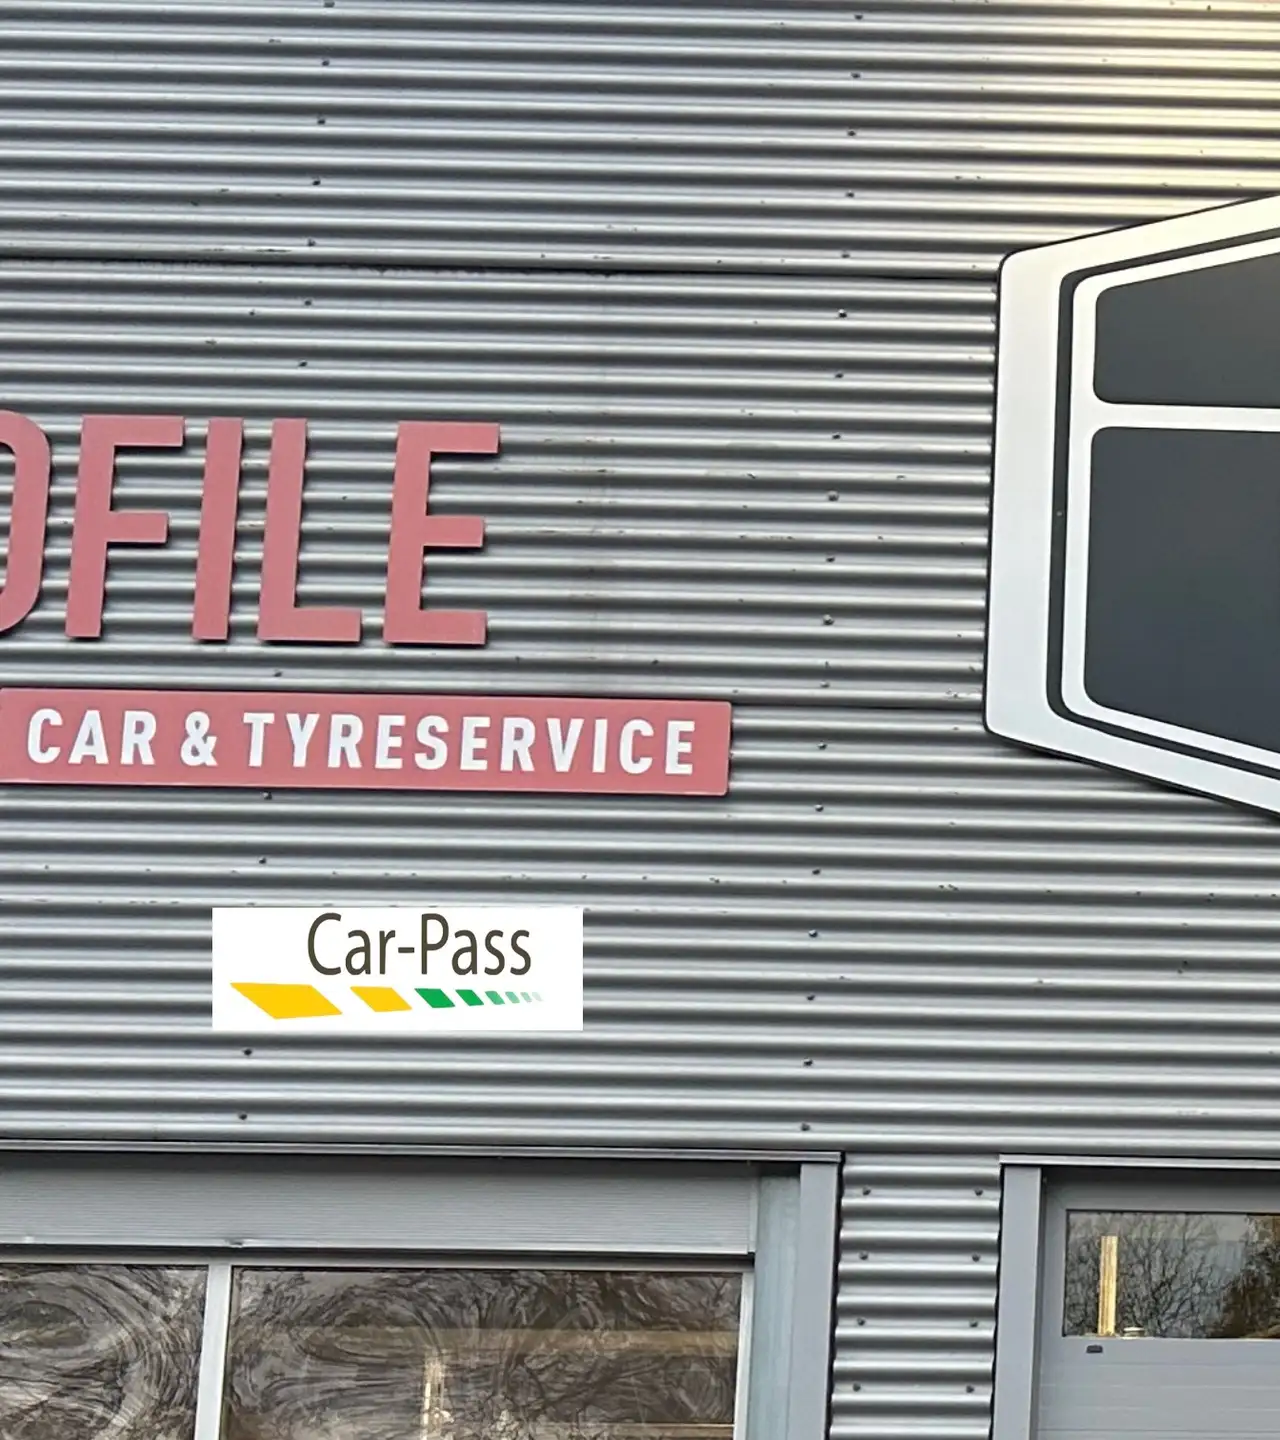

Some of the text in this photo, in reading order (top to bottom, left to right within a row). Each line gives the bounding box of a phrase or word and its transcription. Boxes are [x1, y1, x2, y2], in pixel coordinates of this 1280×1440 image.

[27, 708, 697, 776] CAR & TYRESERVICE
